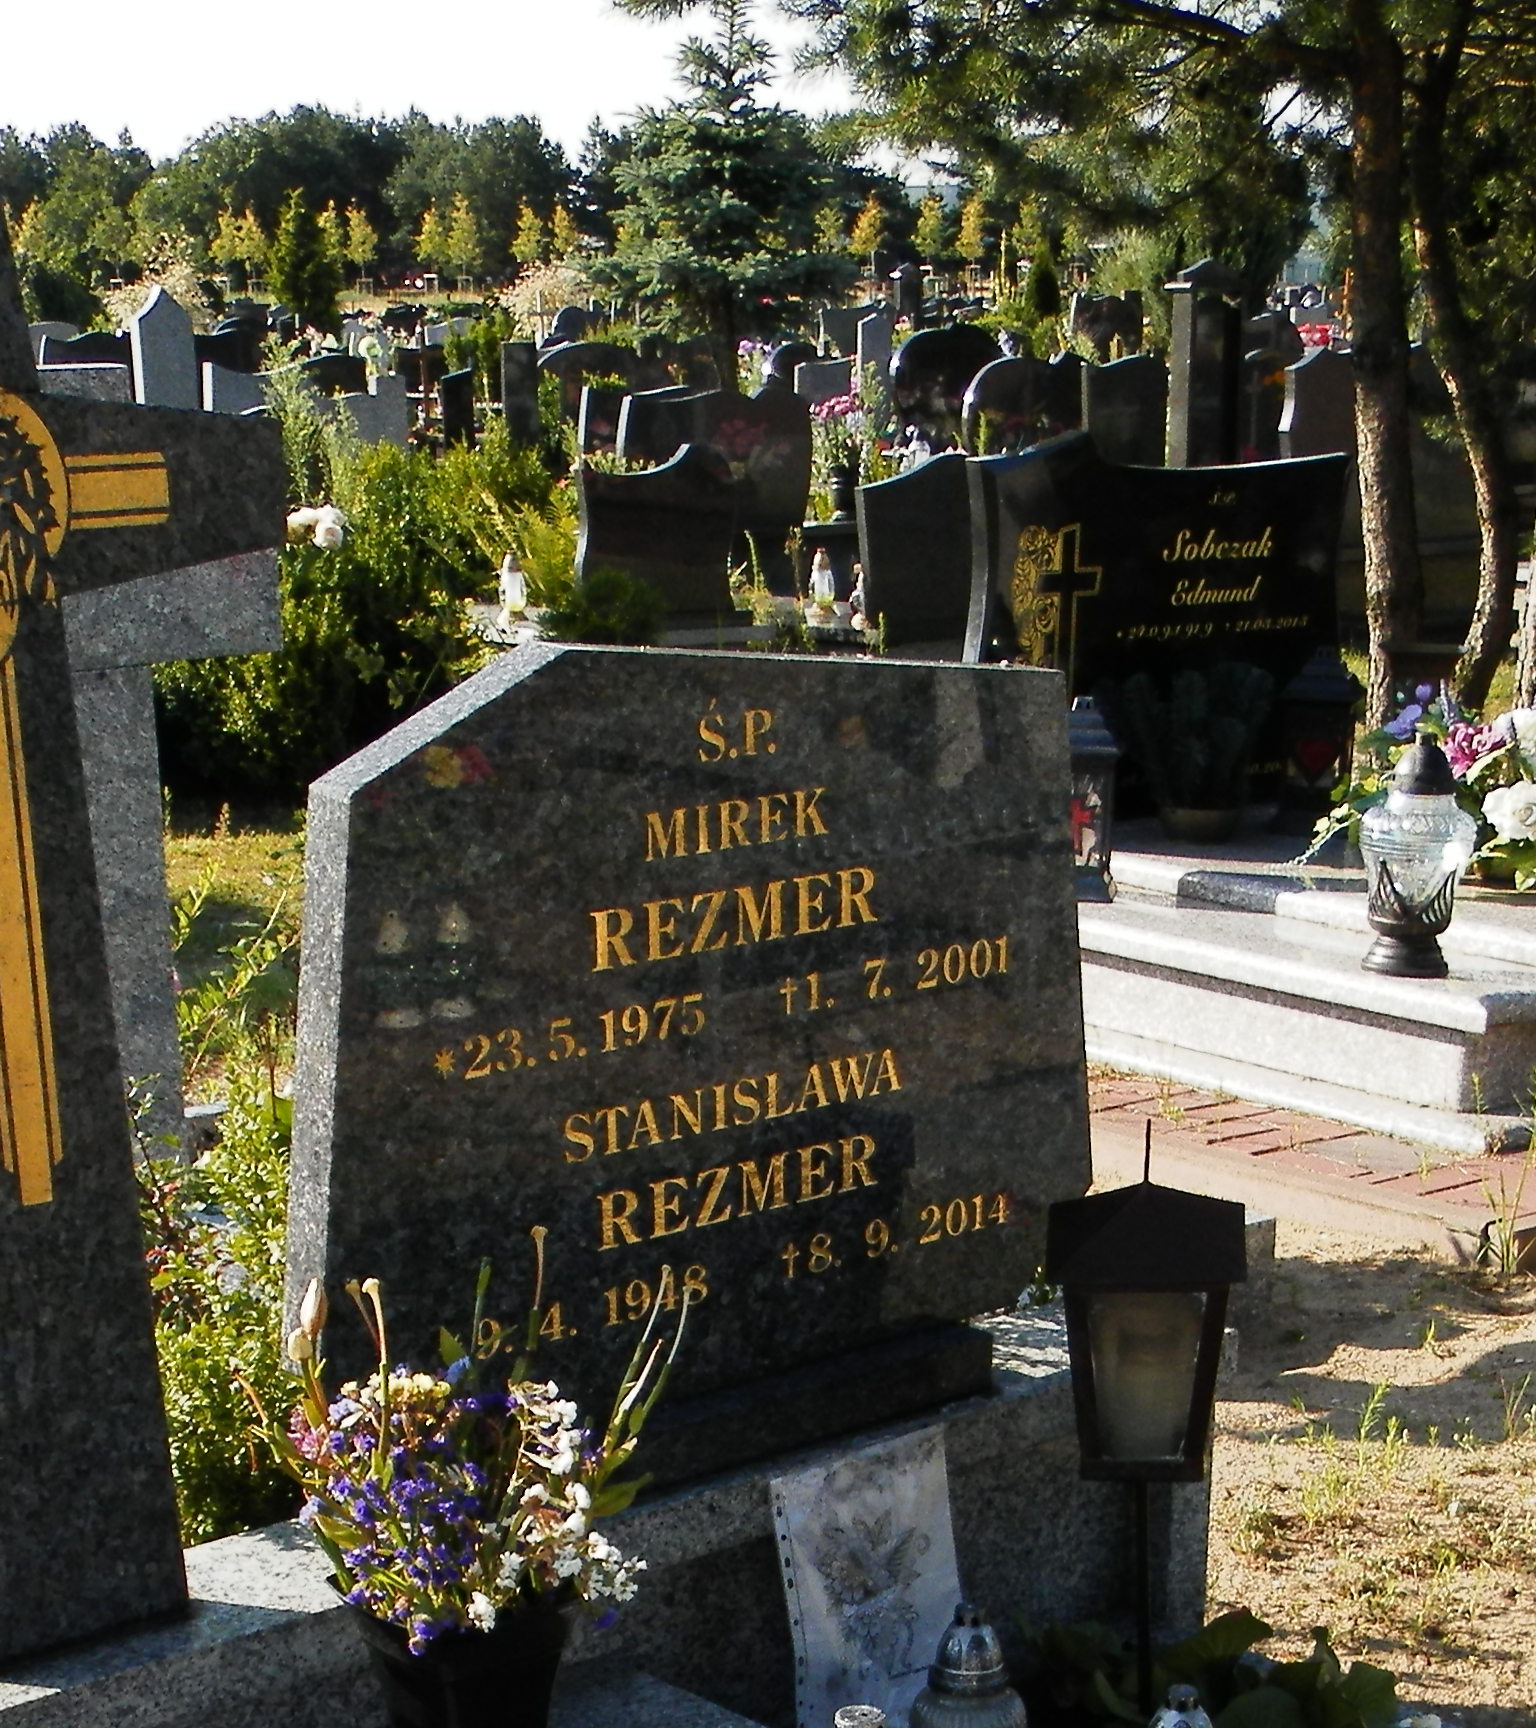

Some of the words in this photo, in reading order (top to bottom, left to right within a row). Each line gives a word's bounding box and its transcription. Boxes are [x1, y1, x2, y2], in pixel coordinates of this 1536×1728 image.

[1162, 526, 1273, 562] Sobczak
[1170, 575, 1262, 607] Edmund
[698, 697, 778, 763] Ś.P.
[644, 786, 830, 862] MIREK
[589, 865, 879, 973] REZMER
[864, 957, 893, 1000] 7.
[916, 935, 1009, 990] 2001
[595, 1134, 880, 1252] REZMER
[865, 1217, 900, 1259] 9.
[919, 1192, 1011, 1245] 2014
